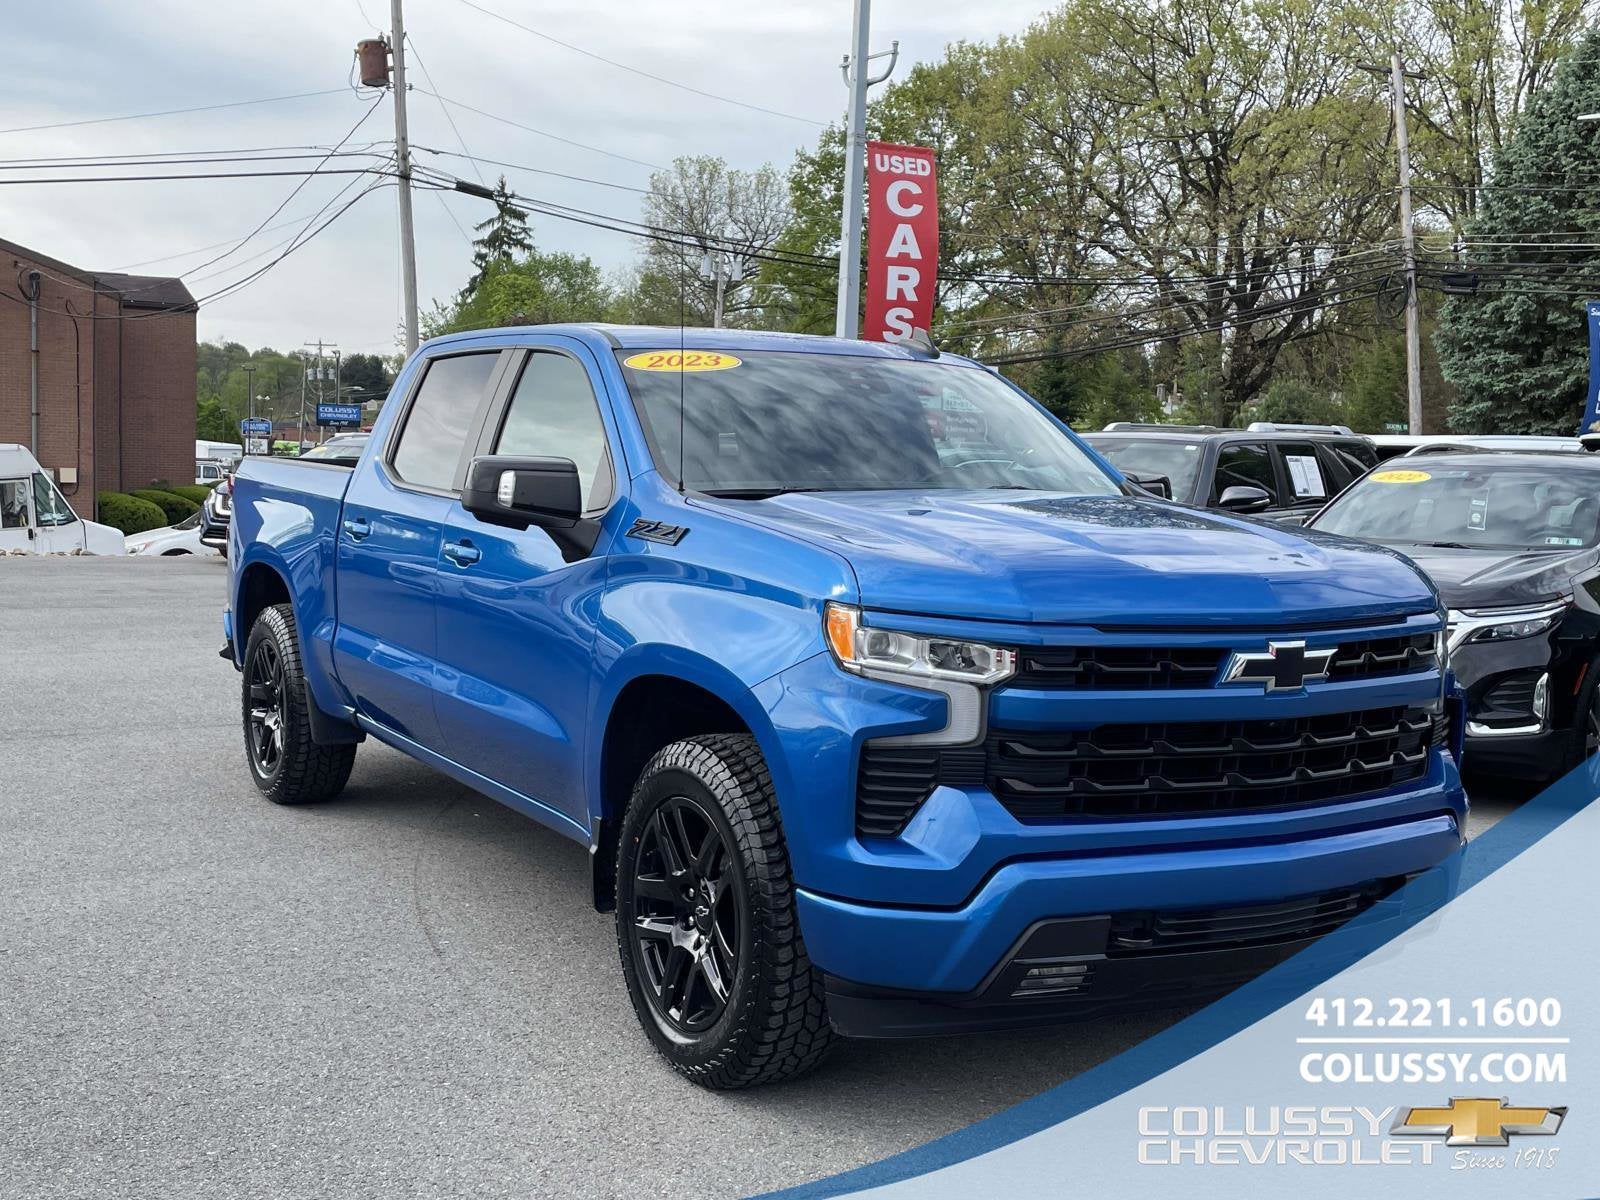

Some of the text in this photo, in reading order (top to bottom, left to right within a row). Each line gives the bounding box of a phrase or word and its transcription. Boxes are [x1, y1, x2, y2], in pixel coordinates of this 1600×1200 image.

[874, 153, 931, 177] USED
[882, 180, 924, 344] CARS
[647, 354, 721, 369] 2023
[319, 406, 359, 414] COLUSSY
